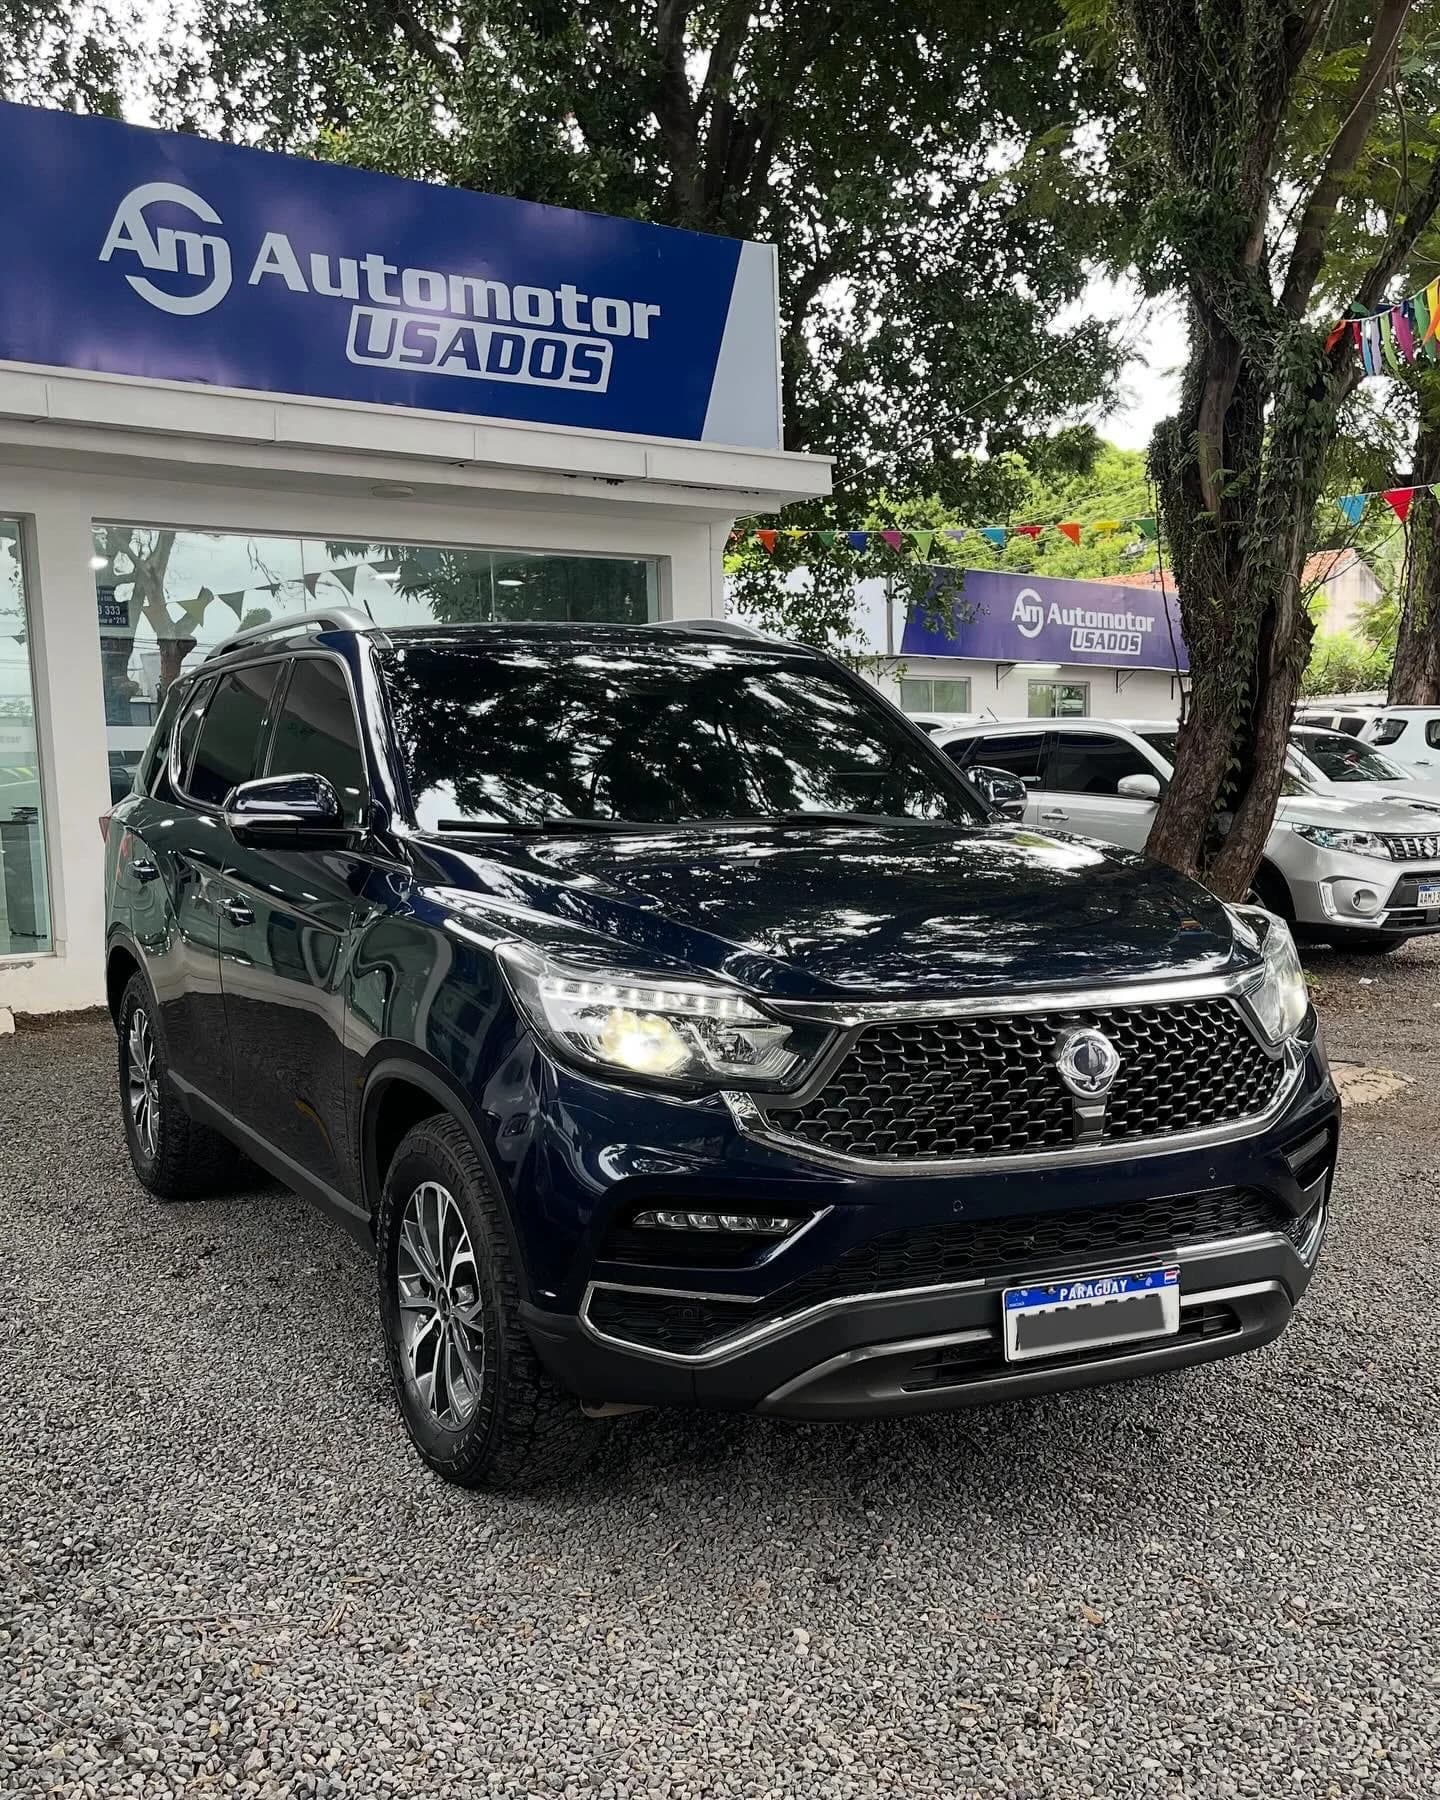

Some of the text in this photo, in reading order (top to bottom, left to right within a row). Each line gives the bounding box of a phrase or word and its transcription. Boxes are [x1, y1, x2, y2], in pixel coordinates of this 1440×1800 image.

[248, 232, 660, 340] Automotor
[353, 314, 606, 385] USADOS
[1047, 603, 1154, 632] Automotor
[1072, 632, 1140, 652] USADOS
[1060, 1280, 1128, 1301] PARAGUAY
